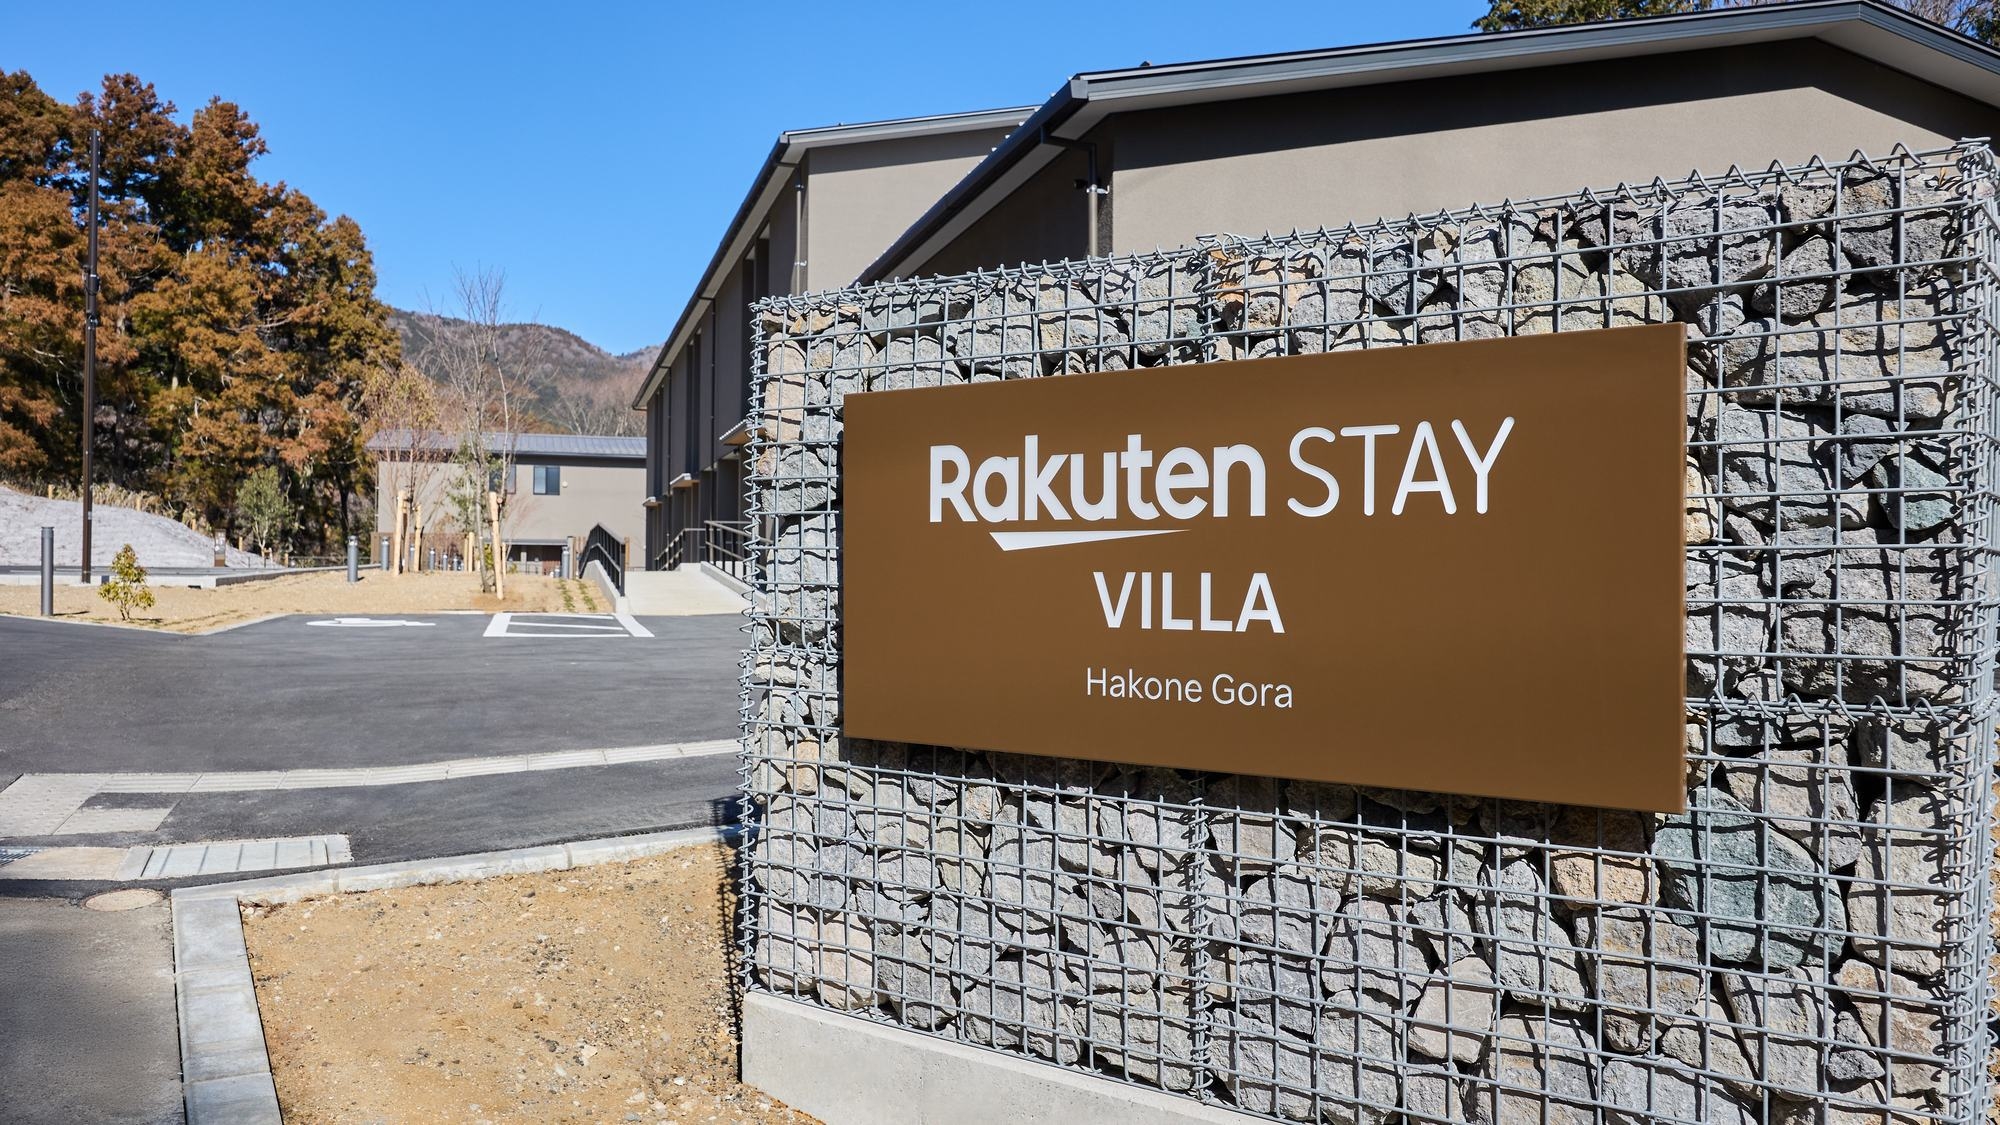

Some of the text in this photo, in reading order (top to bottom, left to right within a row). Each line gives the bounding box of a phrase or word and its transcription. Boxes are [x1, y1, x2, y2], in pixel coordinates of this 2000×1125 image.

[929, 416, 1515, 523] Rakuten STAY
[1092, 571, 1286, 634] VILLA
[1085, 667, 1294, 708] Hakone Gora
